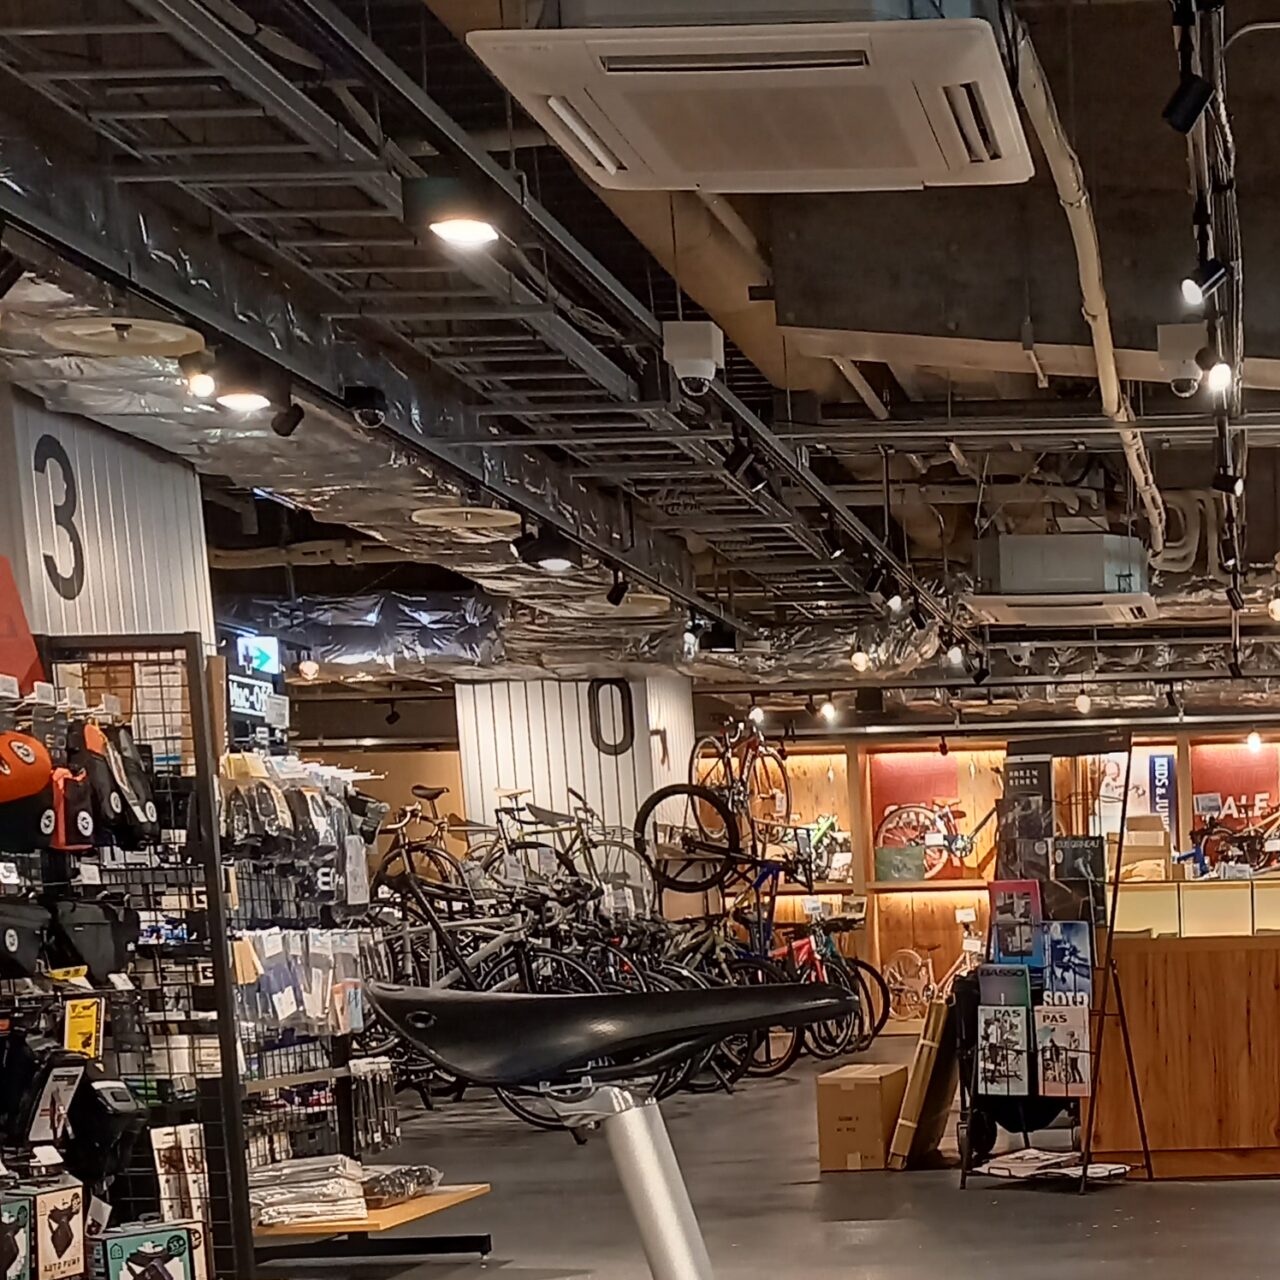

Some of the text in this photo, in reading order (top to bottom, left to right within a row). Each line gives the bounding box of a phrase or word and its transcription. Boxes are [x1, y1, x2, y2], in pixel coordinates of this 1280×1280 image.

[34, 434, 85, 600] 3
[994, 1009, 1021, 1018] PAS
[1042, 1014, 1068, 1023] PAS
